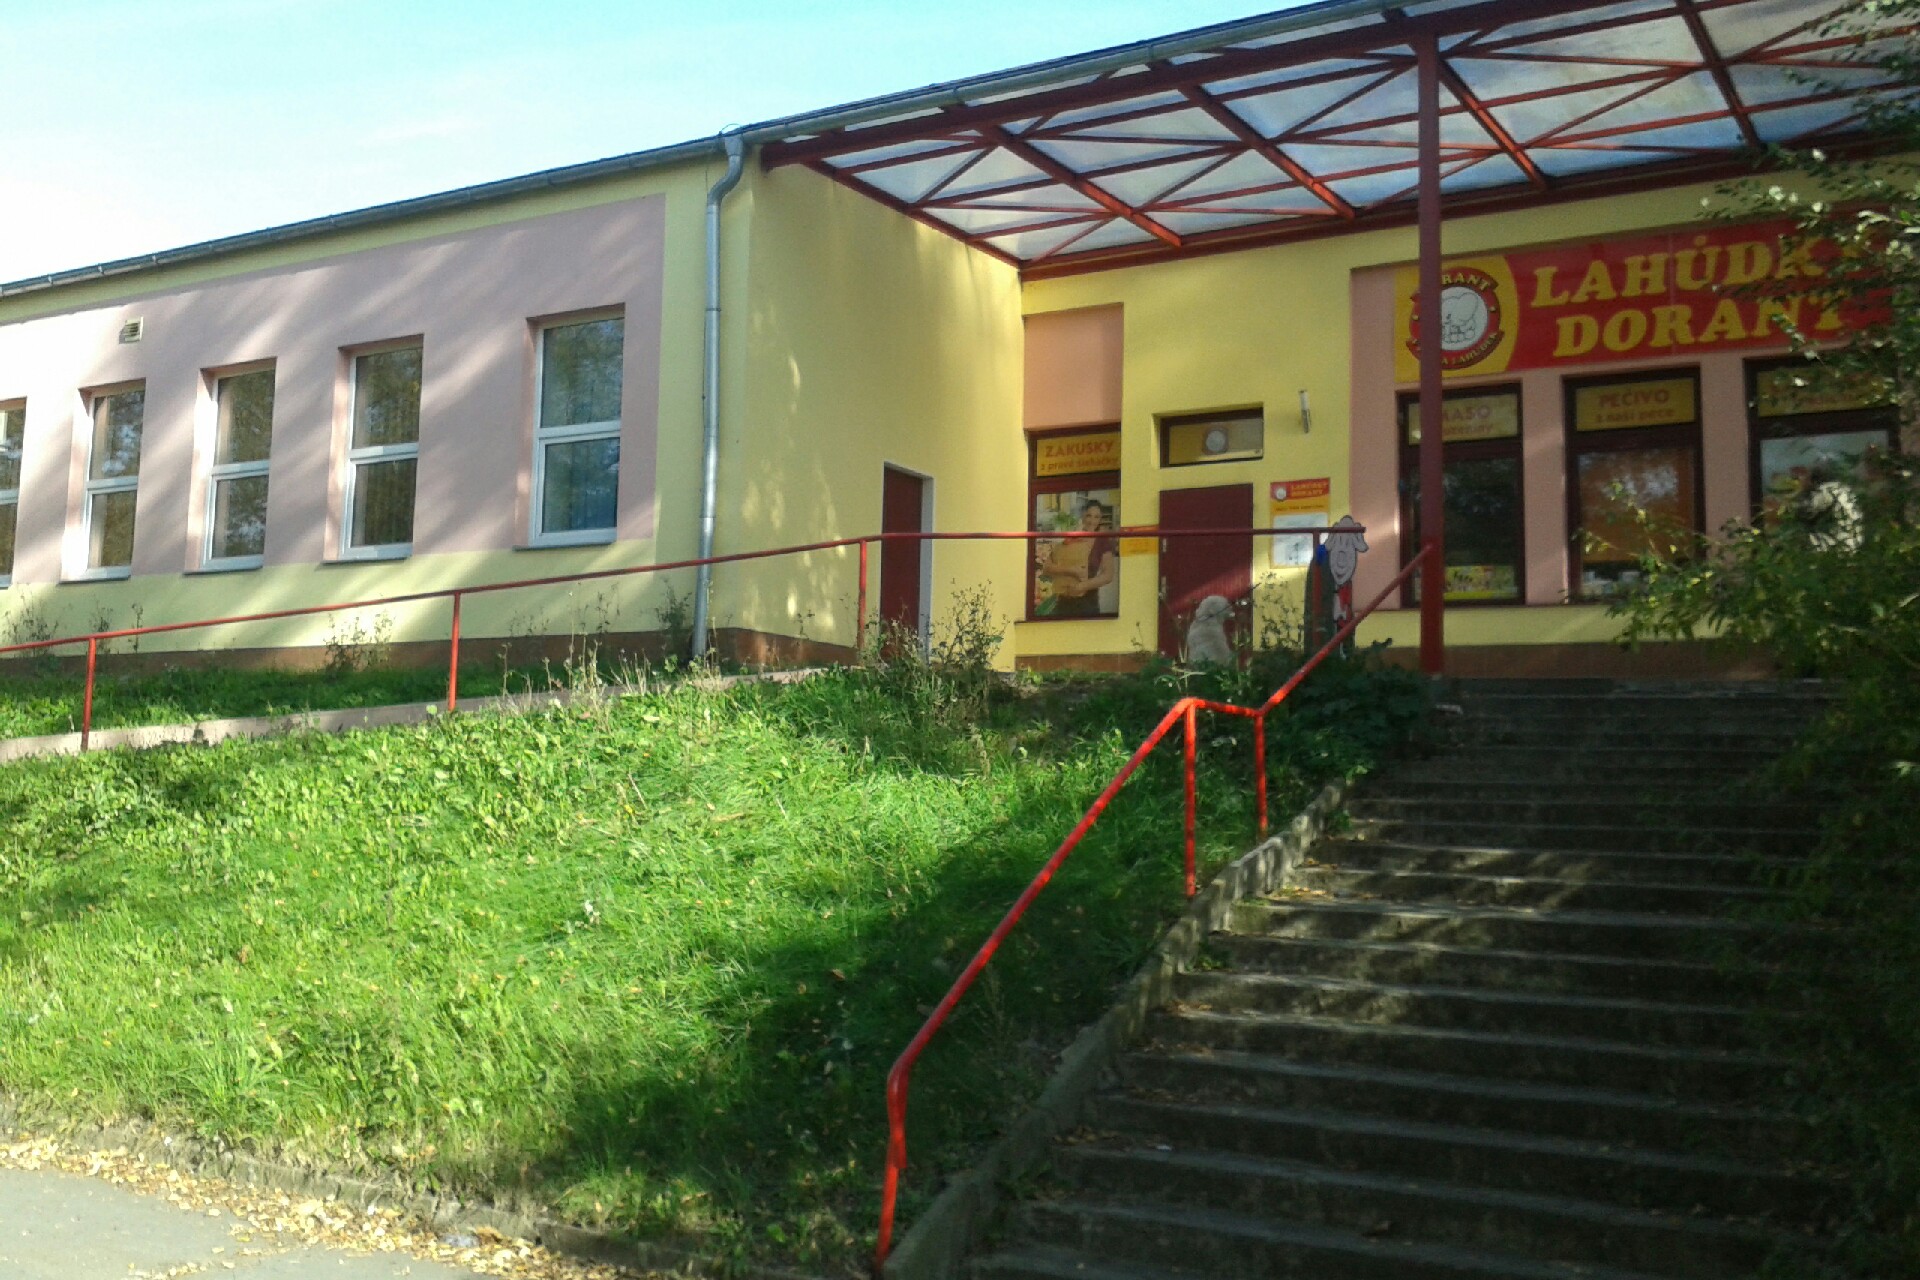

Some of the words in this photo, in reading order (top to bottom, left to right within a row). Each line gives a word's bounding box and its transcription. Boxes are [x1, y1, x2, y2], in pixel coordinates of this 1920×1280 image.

[1553, 289, 1846, 357] DORANT
[1599, 387, 1670, 408] PEČIVO
[1045, 440, 1114, 458] ZAKUSKY
